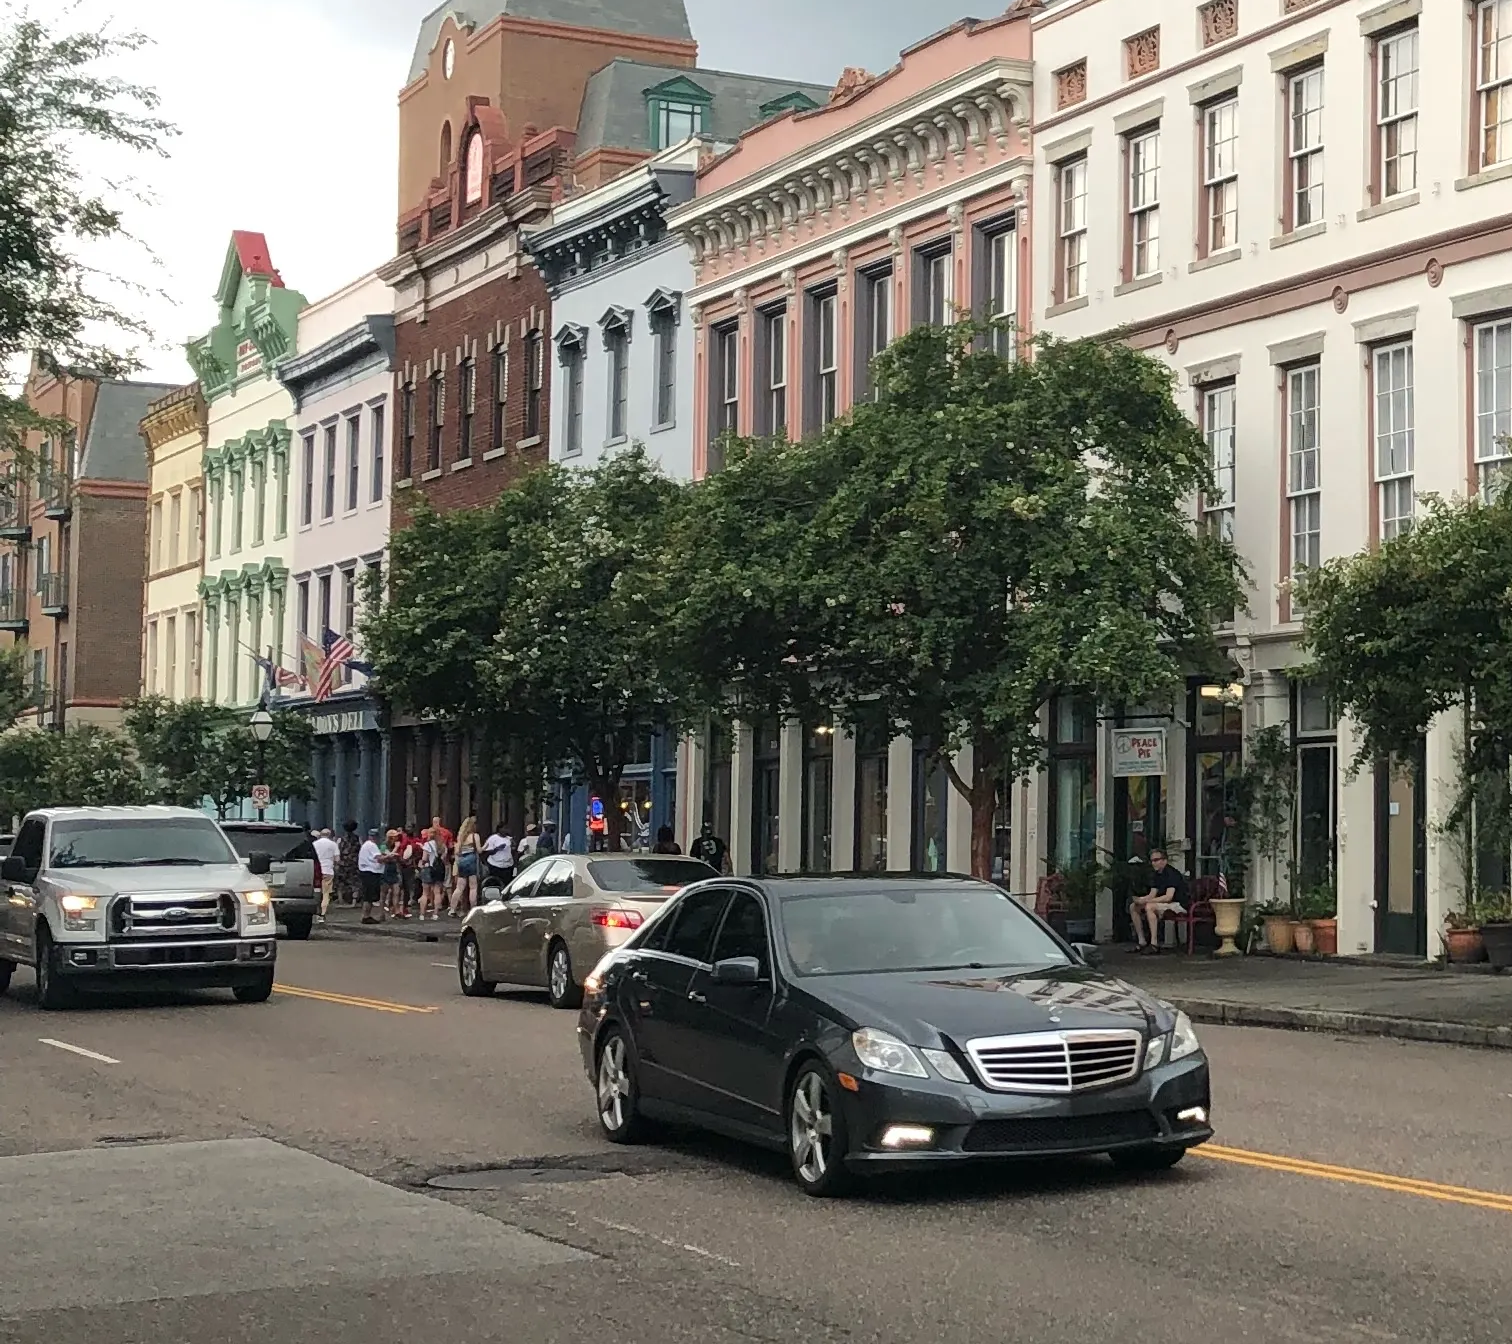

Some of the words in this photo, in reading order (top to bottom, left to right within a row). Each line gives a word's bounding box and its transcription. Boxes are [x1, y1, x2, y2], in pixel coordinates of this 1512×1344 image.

[340, 710, 364, 733] DELI
[1131, 738, 1158, 748] PEACE
[1138, 748, 1151, 759] PIE
